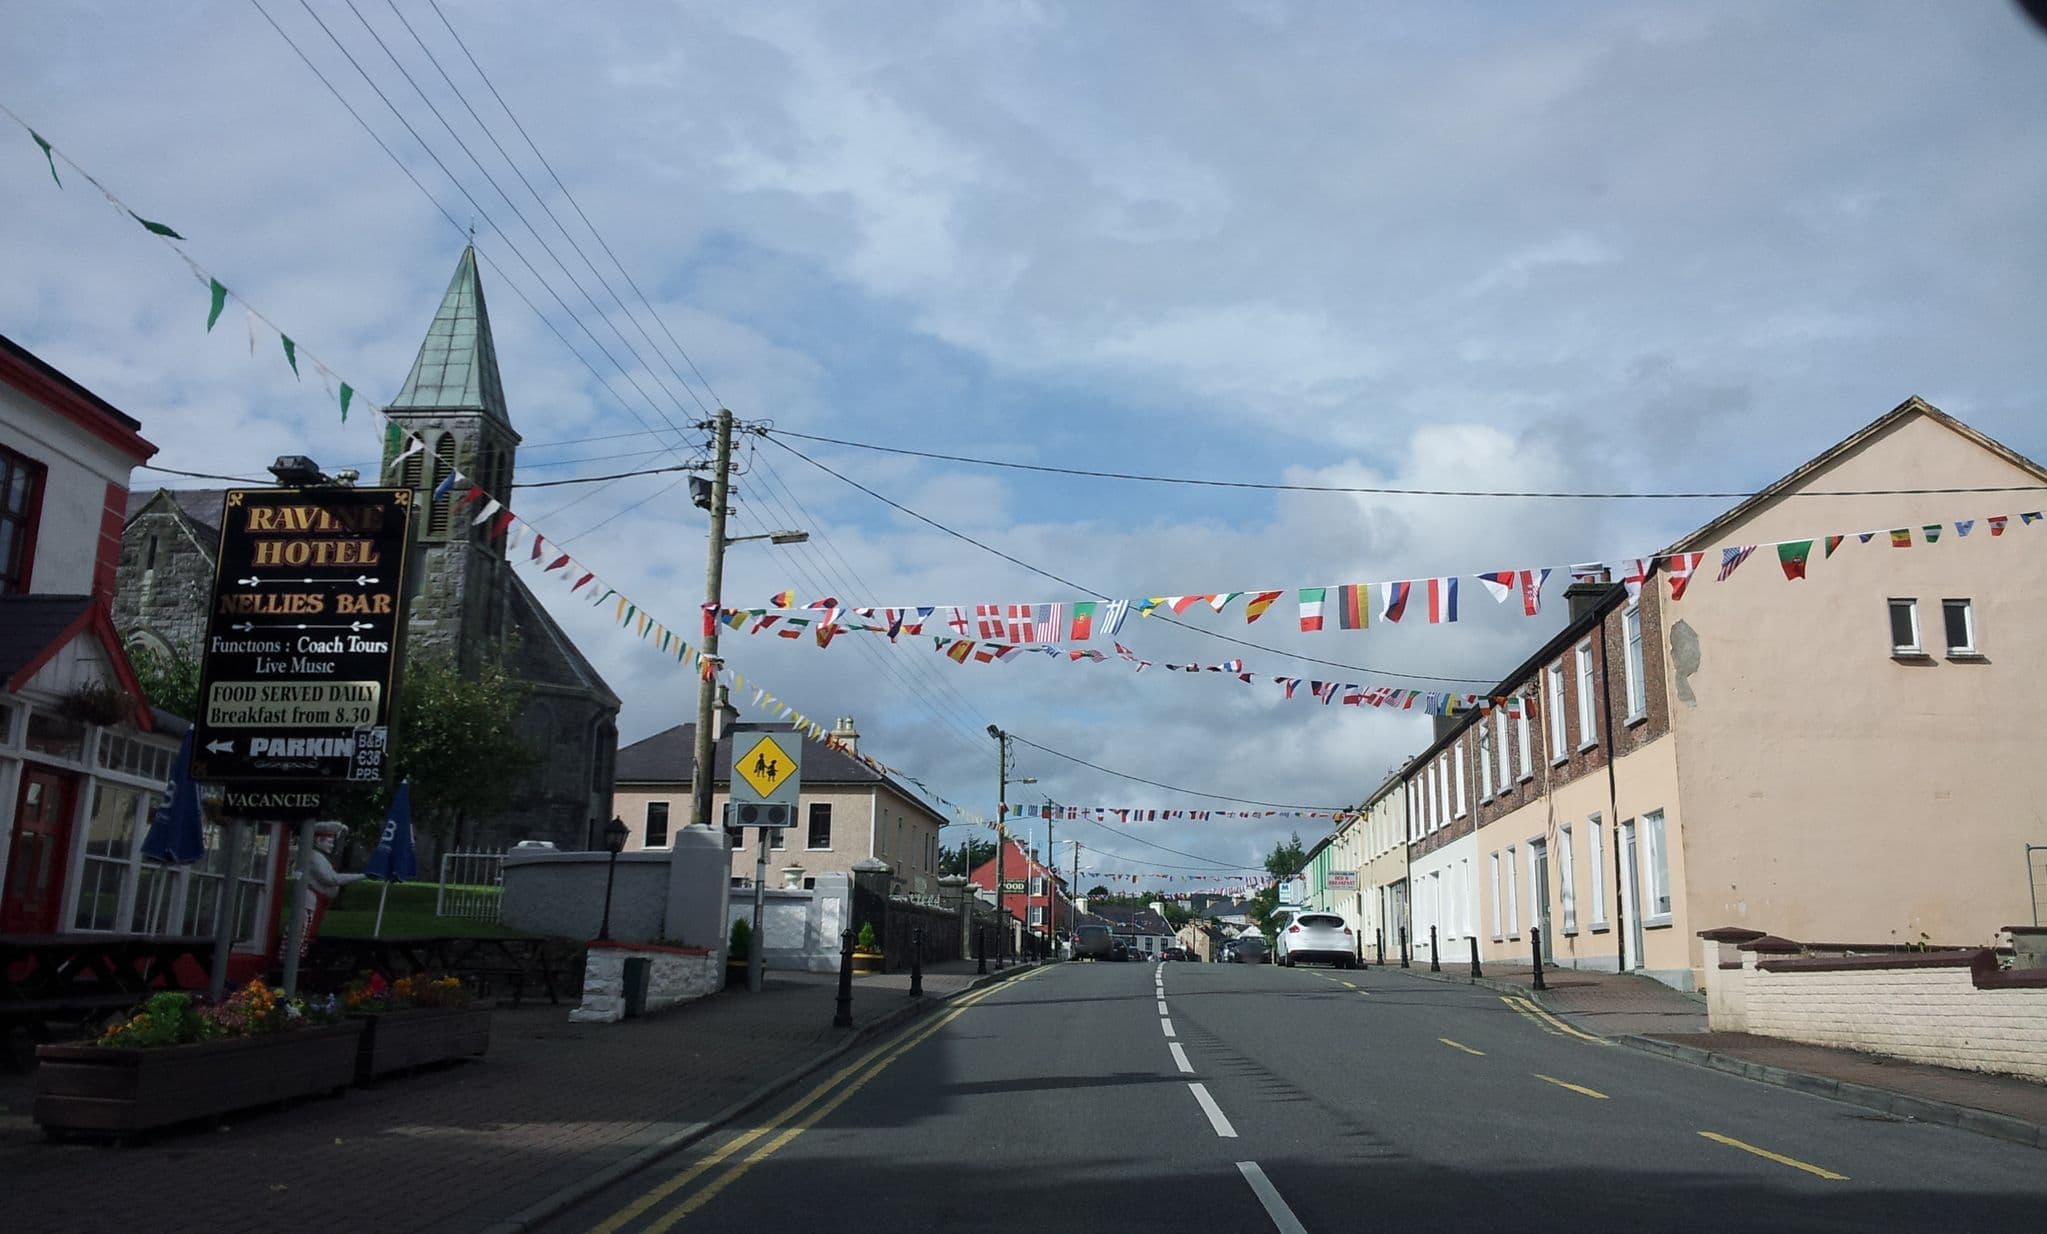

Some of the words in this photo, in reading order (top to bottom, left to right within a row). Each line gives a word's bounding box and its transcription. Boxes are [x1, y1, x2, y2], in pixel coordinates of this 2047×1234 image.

[253, 540, 380, 566] HOTEL
[219, 594, 324, 614] NELLIES
[336, 594, 391, 614] BAR
[211, 636, 281, 653] Functions
[297, 636, 344, 653] Coach
[347, 635, 388, 653] Tours
[256, 657, 287, 673] Live
[290, 657, 336, 673] Music
[212, 686, 256, 702] FOOD
[261, 686, 324, 702] SERVED
[328, 685, 377, 702] DAILY
[210, 707, 286, 724] Breakfast
[292, 707, 330, 723] from
[335, 707, 370, 723] 8.30
[250, 737, 355, 757] PARKIN
[226, 793, 320, 808] VACANCIES
